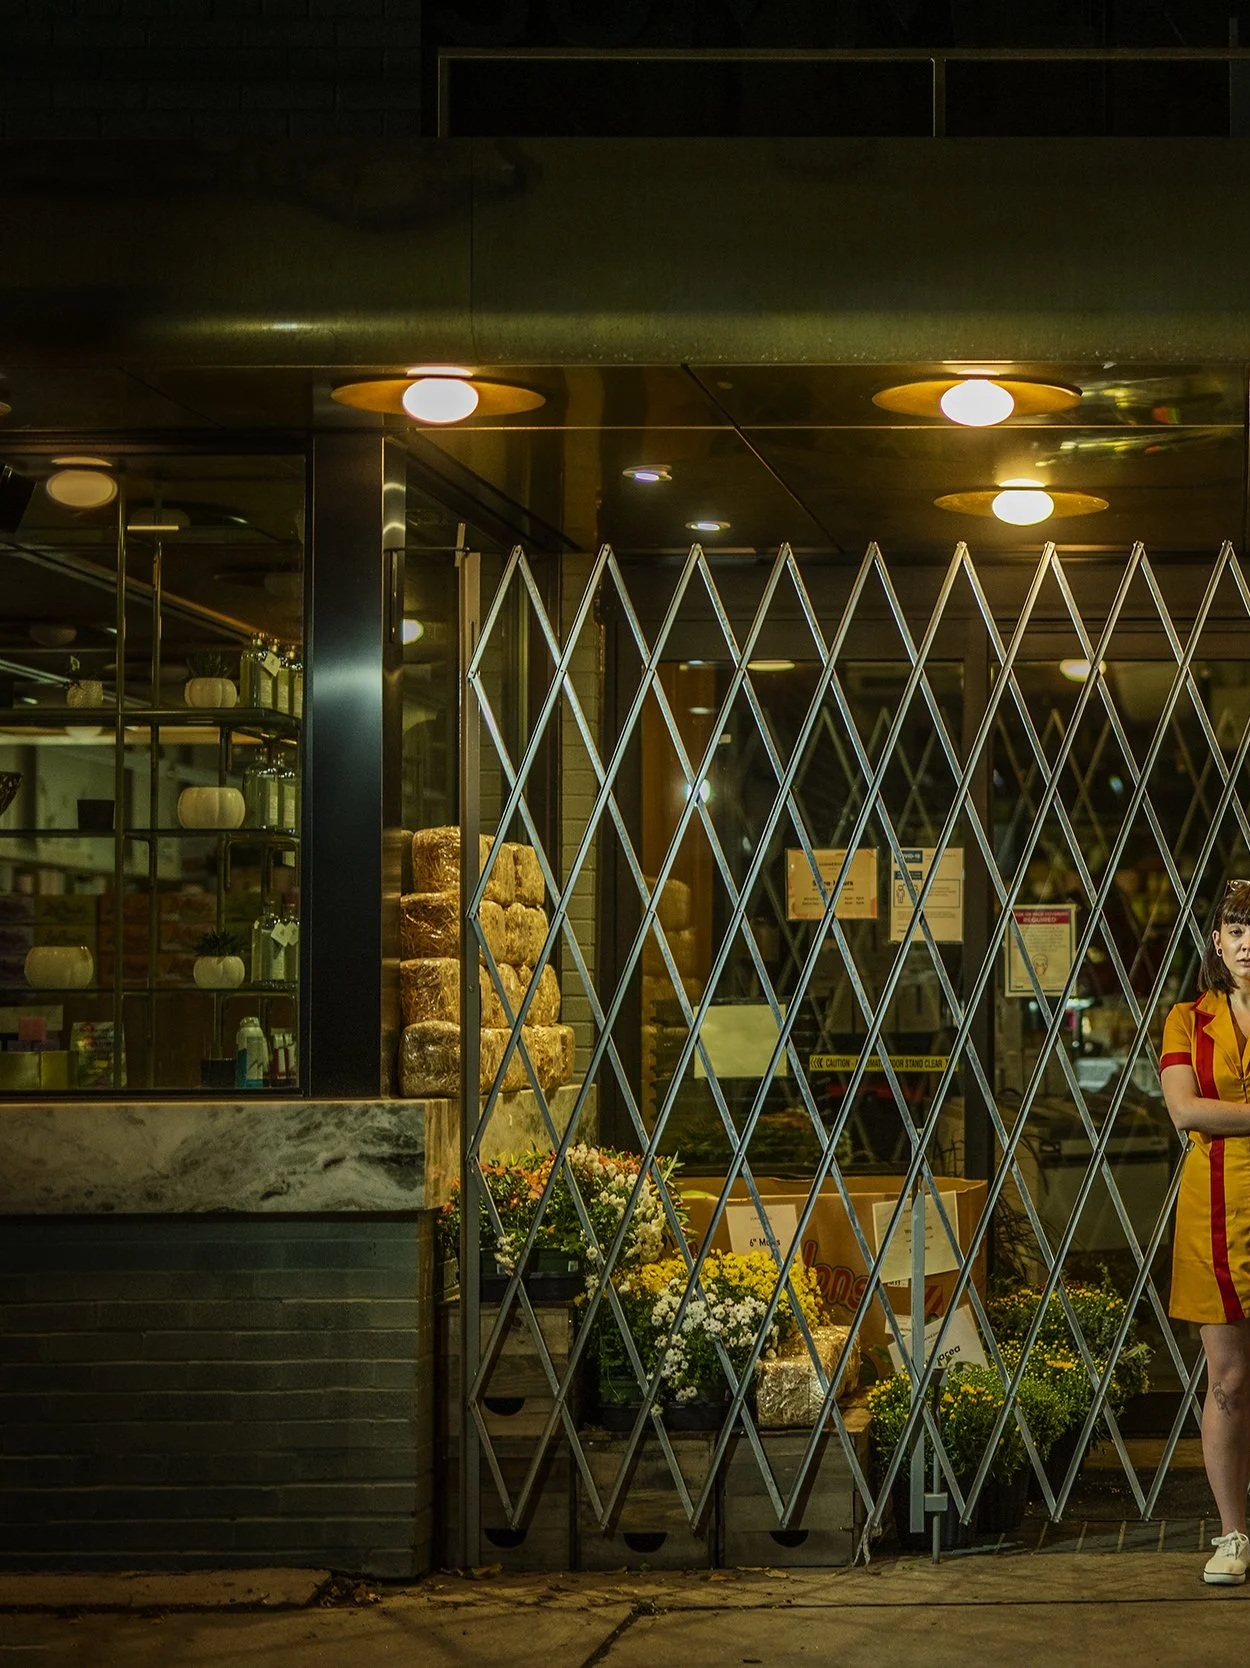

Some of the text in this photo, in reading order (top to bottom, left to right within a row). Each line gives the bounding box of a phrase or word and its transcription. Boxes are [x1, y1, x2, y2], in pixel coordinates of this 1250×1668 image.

[826, 1059, 849, 1068] CAUTION
[905, 1059, 923, 1068] STAND
[925, 1059, 943, 1068] CLEAR
